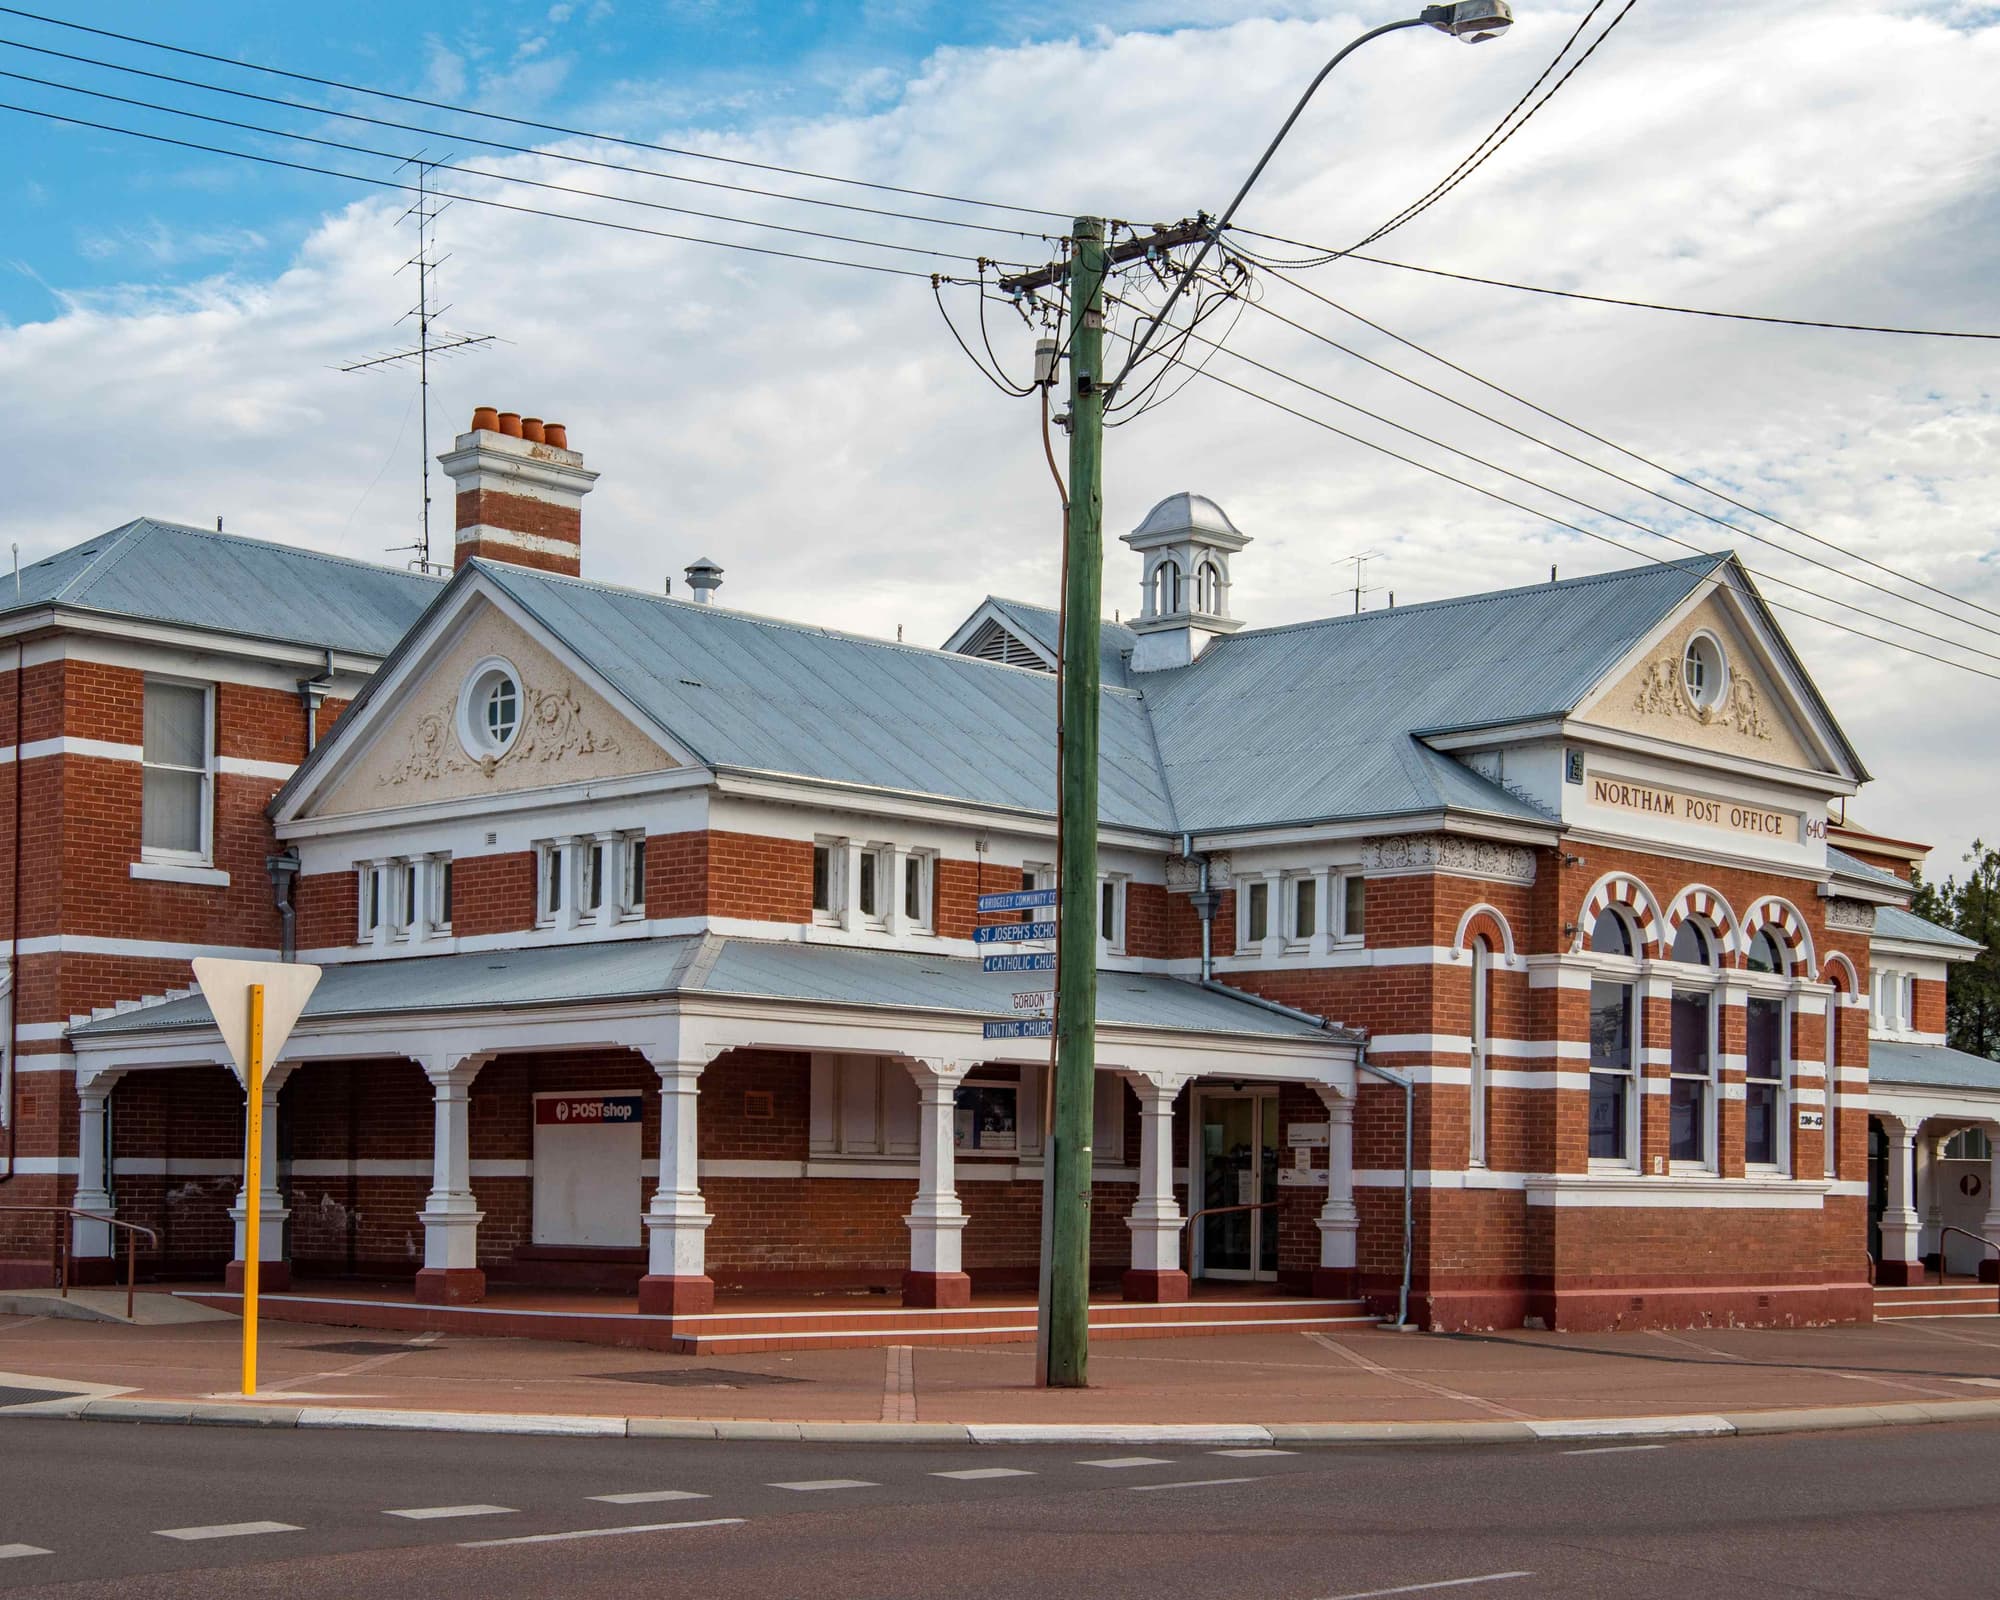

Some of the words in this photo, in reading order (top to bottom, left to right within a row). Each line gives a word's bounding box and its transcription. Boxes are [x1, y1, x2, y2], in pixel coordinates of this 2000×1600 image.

[1595, 781, 1674, 815] NORTHAM
[1686, 799, 1720, 823] POST
[1731, 808, 1782, 834] OFFICE
[1015, 893, 1046, 906] COMMUNITY
[981, 928, 990, 941] ST
[992, 926, 1030, 941] JOSEPH'S
[1033, 923, 1056, 938] SCHO
[992, 956, 1031, 970] CATHOLIC
[1013, 993, 1045, 1009] GORDON
[986, 1023, 1020, 1037] UNITING
[572, 1102, 632, 1120] POSTshop
